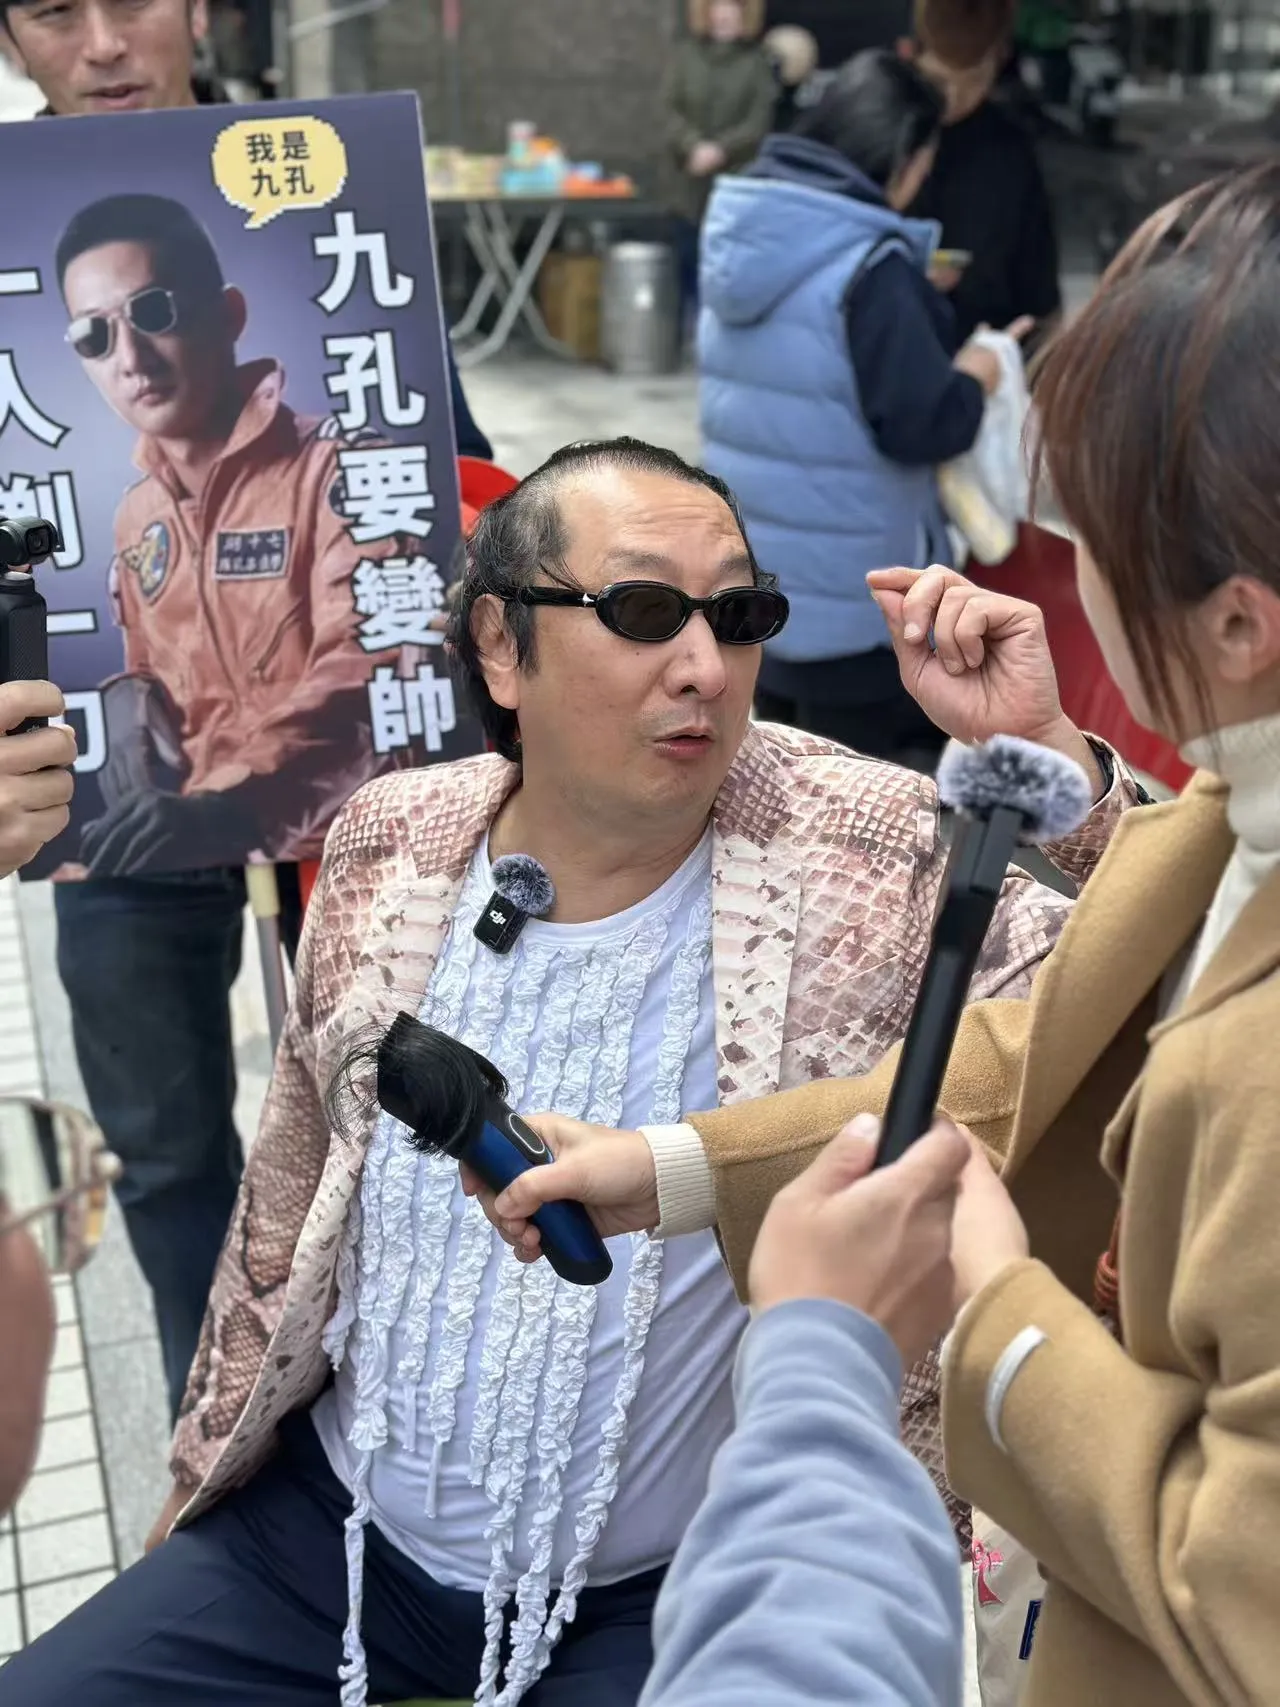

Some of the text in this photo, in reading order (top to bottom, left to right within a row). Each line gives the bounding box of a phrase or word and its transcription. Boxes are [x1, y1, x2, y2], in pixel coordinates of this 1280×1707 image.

[245, 131, 310, 163] 我是
[251, 165, 314, 197] 九孔
[314, 211, 457, 753] 九孔要變帥
